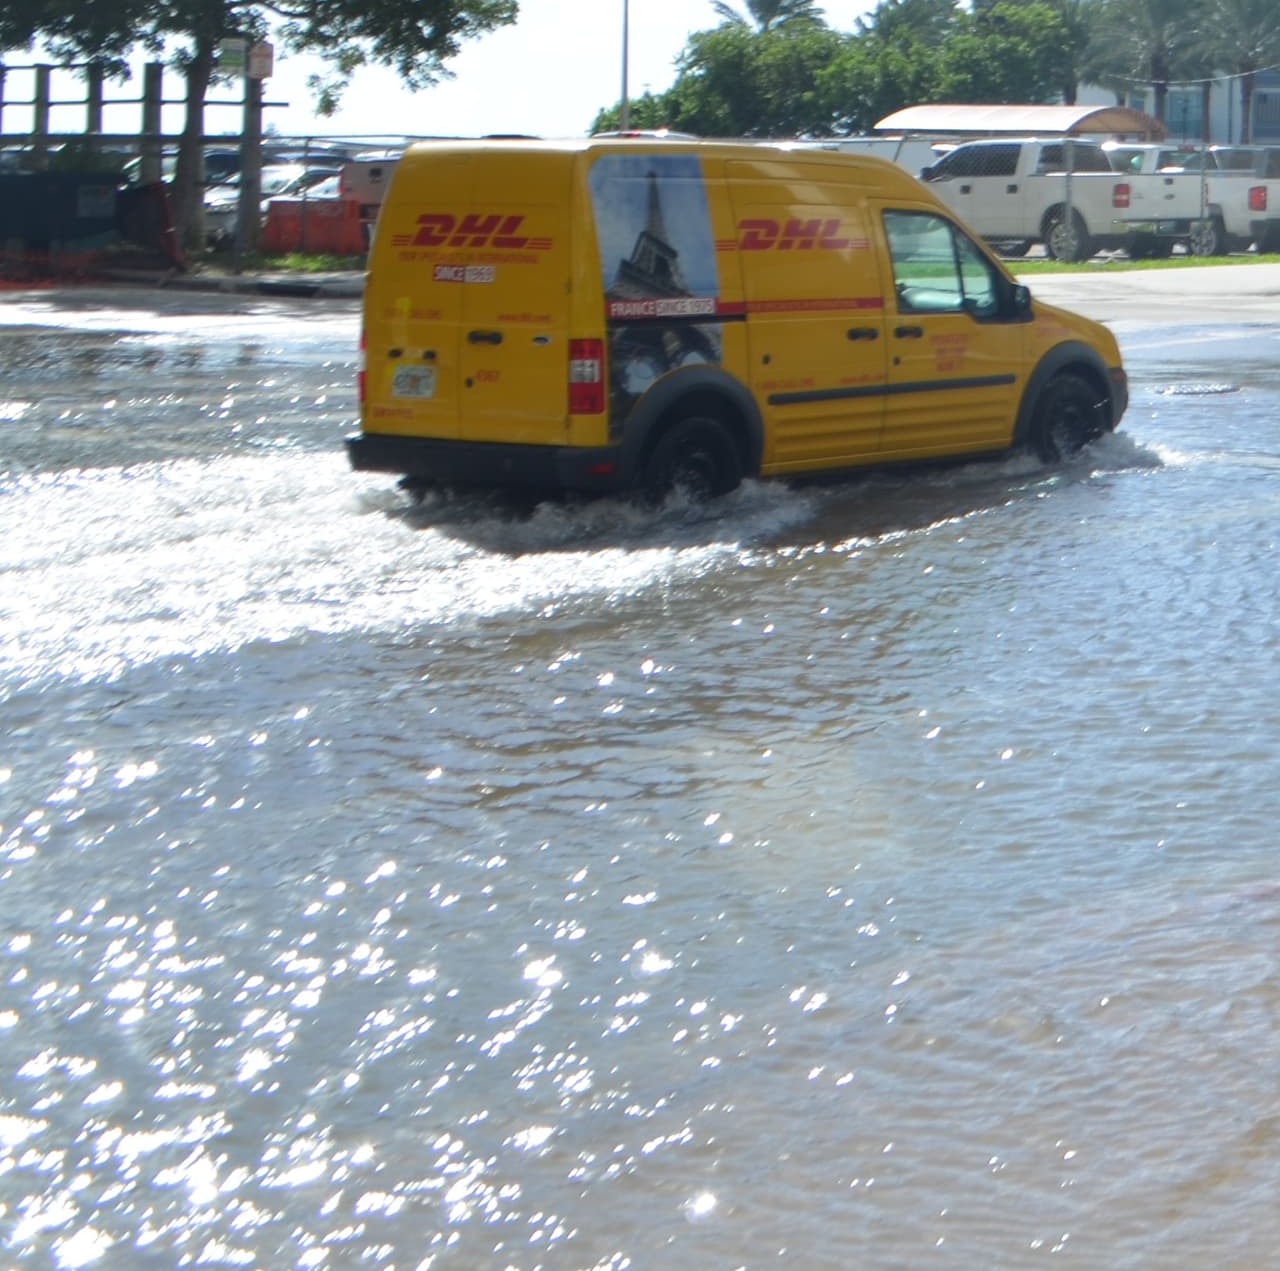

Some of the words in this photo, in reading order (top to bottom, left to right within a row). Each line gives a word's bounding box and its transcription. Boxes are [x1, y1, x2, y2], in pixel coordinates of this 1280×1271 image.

[409, 213, 530, 249] DHL
[737, 218, 851, 251] DHL
[610, 301, 655, 316] FRANCE
